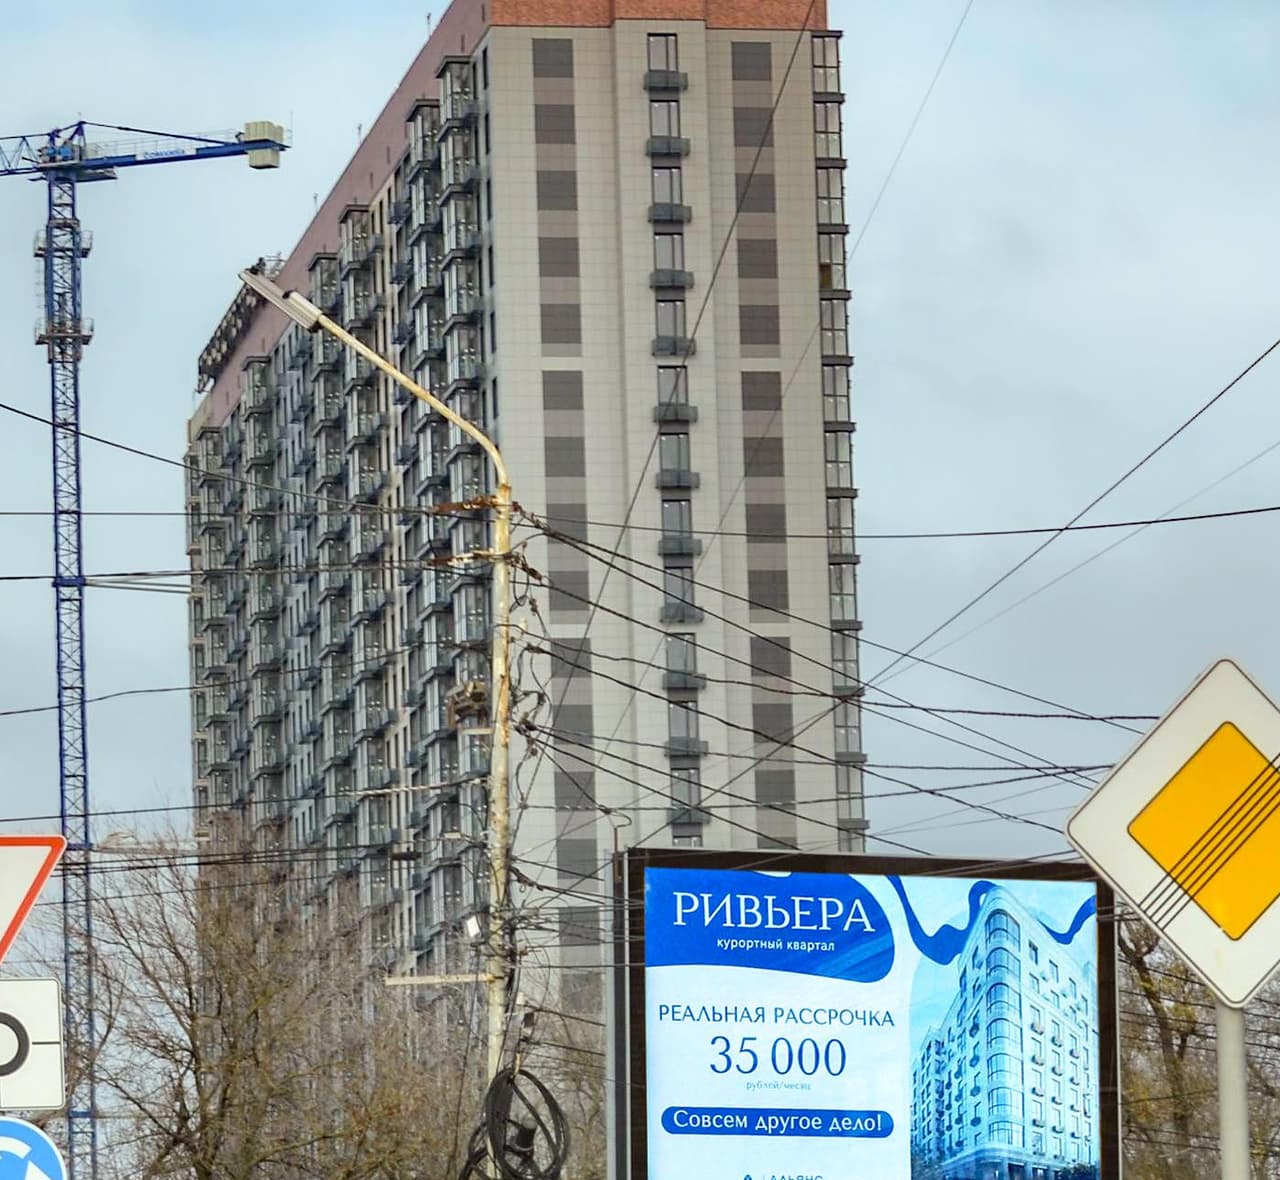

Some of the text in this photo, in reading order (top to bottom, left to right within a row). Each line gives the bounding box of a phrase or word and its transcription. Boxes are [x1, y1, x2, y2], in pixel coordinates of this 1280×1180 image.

[673, 891, 876, 932] РИВЬЕРА
[717, 938, 835, 953] курортный квартал
[659, 1004, 895, 1027] РЕАЛЬНАЯ РАССРОЧКА
[710, 1035, 846, 1076] 35 000
[673, 1110, 882, 1134] Совсем другое дело!
